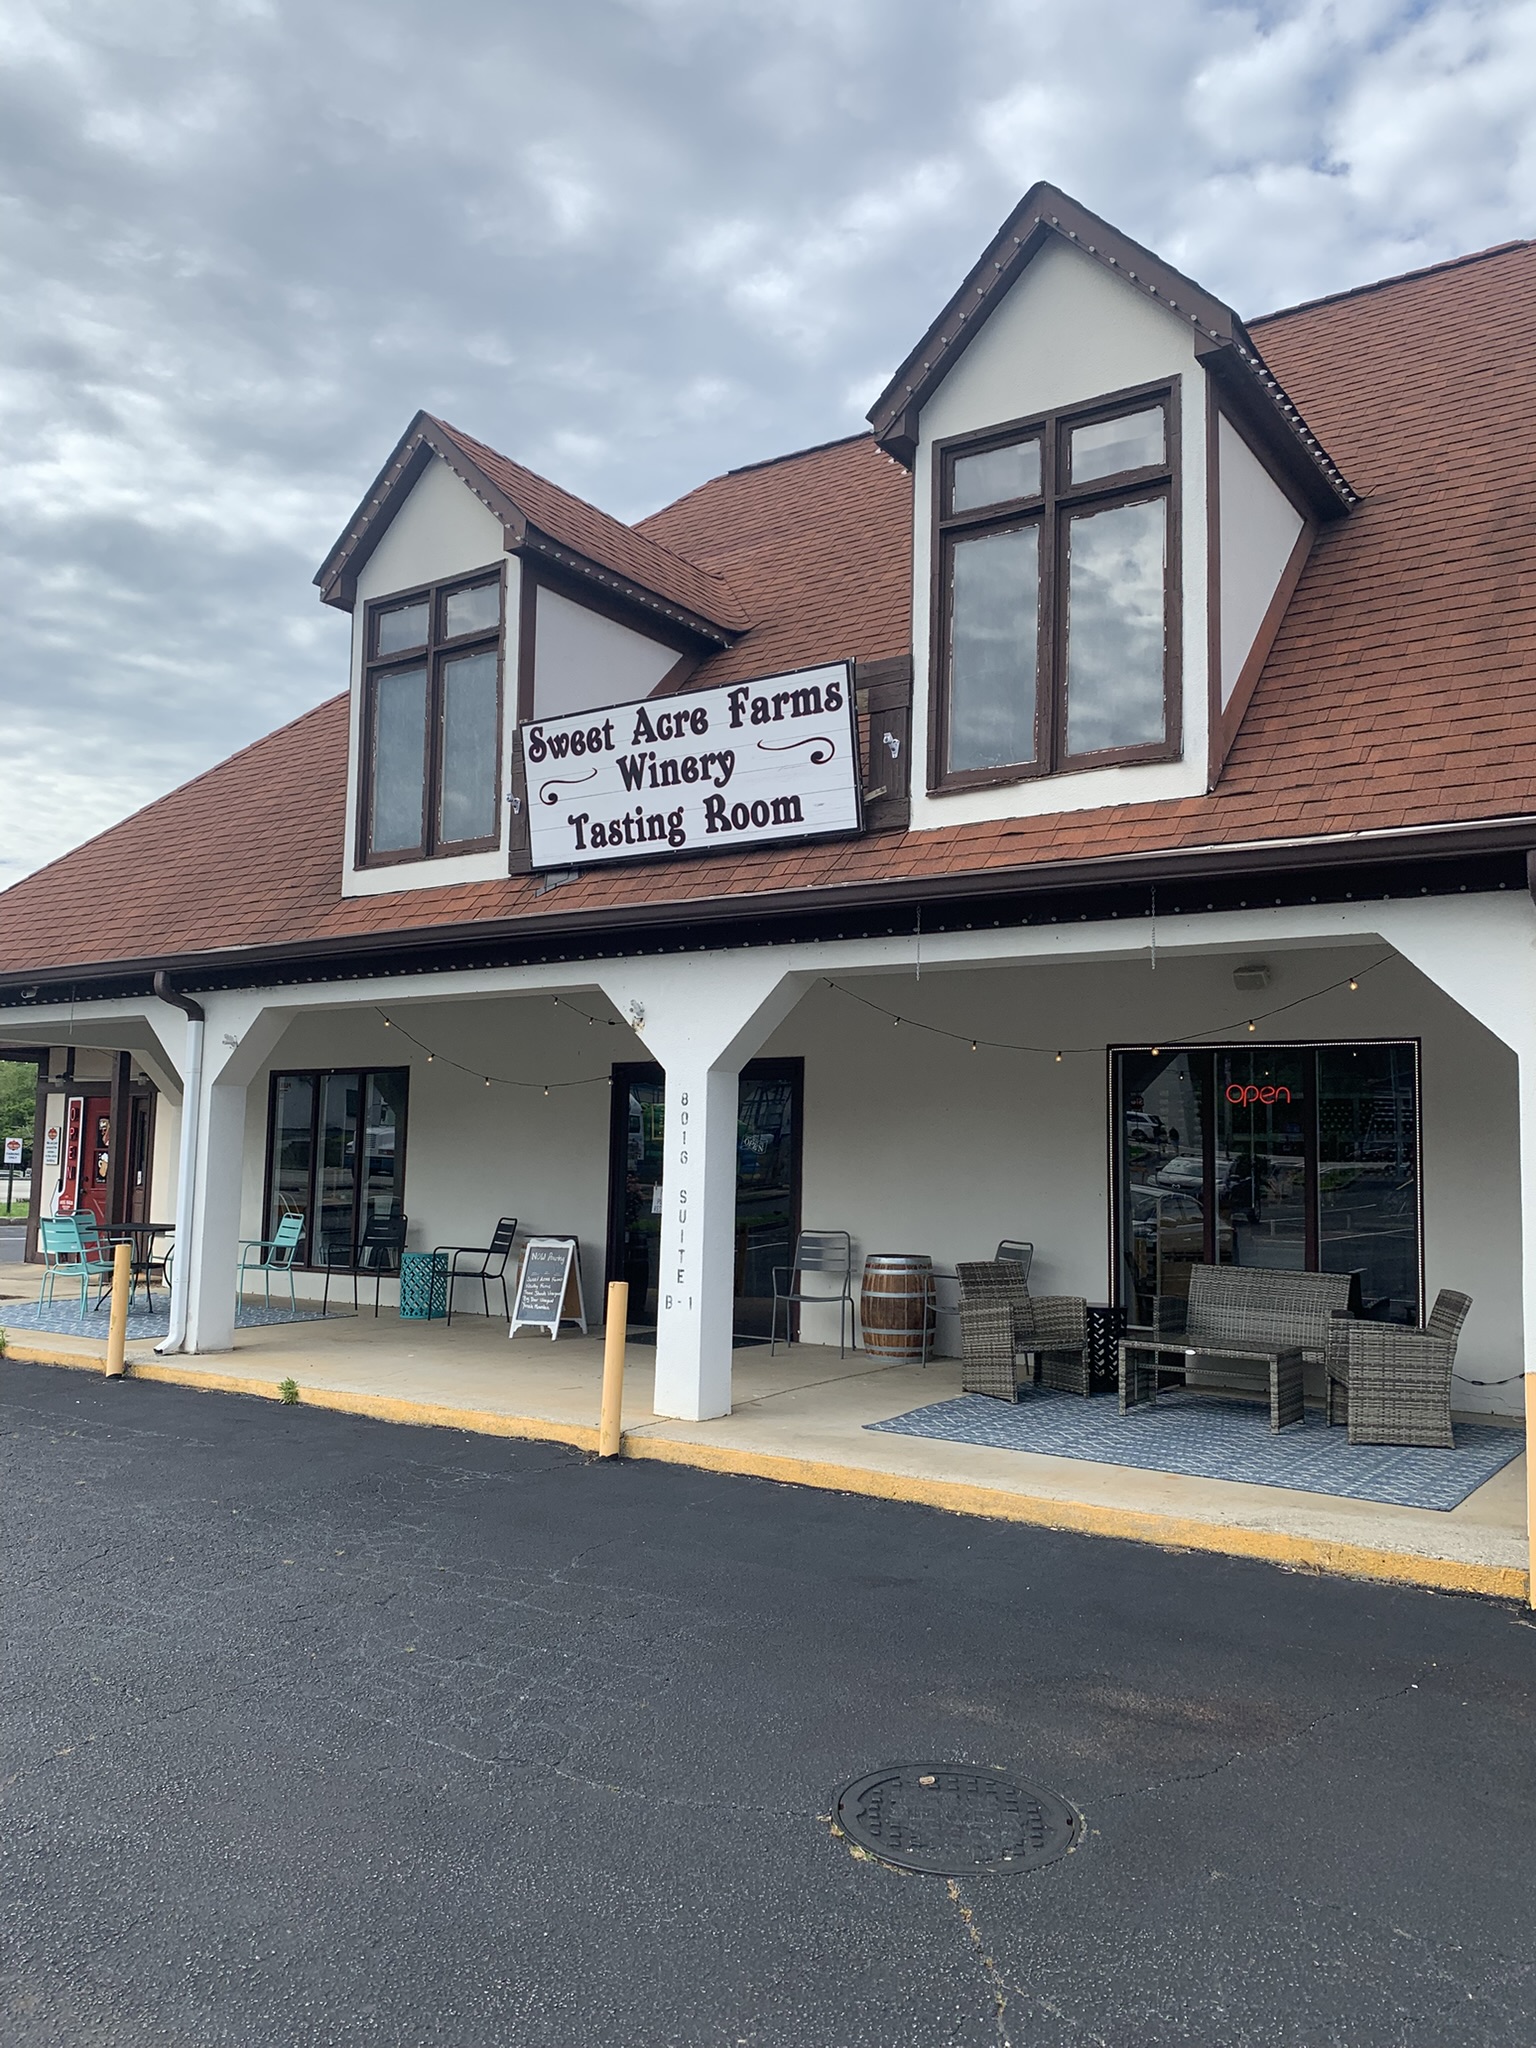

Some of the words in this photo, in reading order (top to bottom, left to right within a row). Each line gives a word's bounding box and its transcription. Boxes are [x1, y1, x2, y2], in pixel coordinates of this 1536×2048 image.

[529, 718, 615, 763] Sweet
[631, 706, 709, 746] Acre
[728, 682, 844, 729] Farms
[616, 749, 736, 792] Winery
[568, 806, 687, 850] Tasting
[703, 793, 804, 834] Room
[1226, 1084, 1290, 1107] open
[66, 1107, 77, 1179] OPEN
[677, 1189, 688, 1284] SUITE
[665, 1295, 693, 1311] B-1
